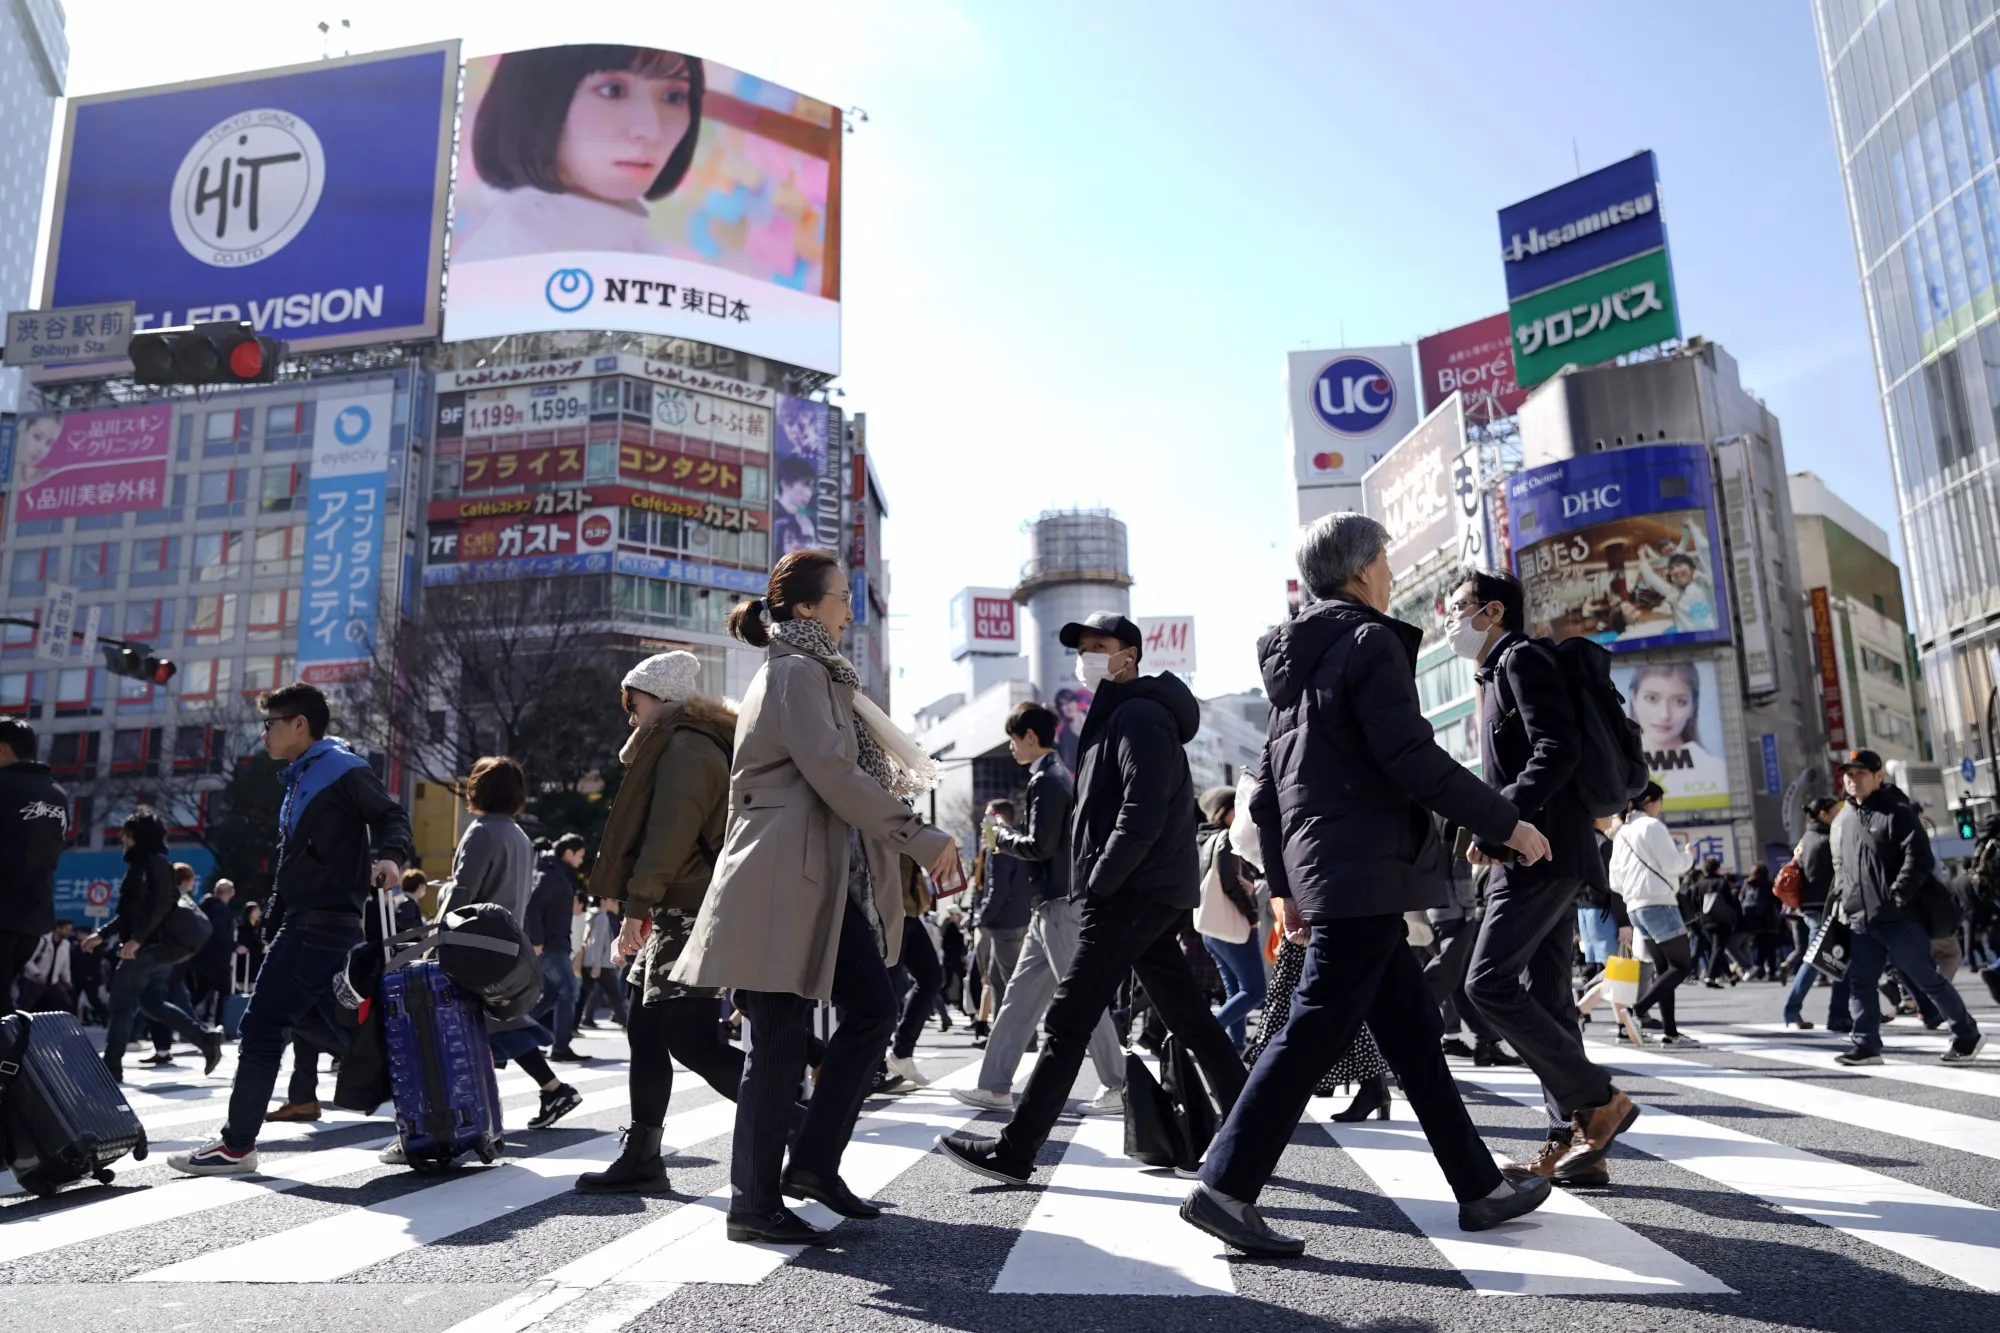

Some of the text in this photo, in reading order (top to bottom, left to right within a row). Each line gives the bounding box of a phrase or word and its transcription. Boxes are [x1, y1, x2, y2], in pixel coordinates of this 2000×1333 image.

[208, 114, 252, 143] TOKYO
[1500, 193, 1655, 262] Hisamitsu
[248, 285, 384, 331] VISION
[1515, 280, 1662, 355] サロンパス
[16, 311, 124, 342] 渋谷駅前
[31, 343, 79, 358] Shibuya
[89, 415, 164, 438] 品川スキン
[440, 406, 463, 425] 9F
[694, 402, 765, 436] しゃぶ葉
[87, 435, 155, 457] クリニック
[321, 447, 379, 468] eyecity
[466, 449, 581, 482] プライス
[620, 445, 738, 488] コンタクト
[36, 477, 157, 510] 品川美容外科
[535, 490, 593, 514] ガスト
[1562, 484, 1622, 518] DHC
[705, 504, 759, 530] ガスト
[430, 535, 458, 556] 7F
[498, 523, 571, 557] ガスト
[309, 492, 348, 646] アイシティ
[344, 488, 376, 644] コンタクトの
[977, 602, 1009, 618] UNI
[977, 619, 1012, 637] QLO
[1144, 622, 1188, 652] H&M
